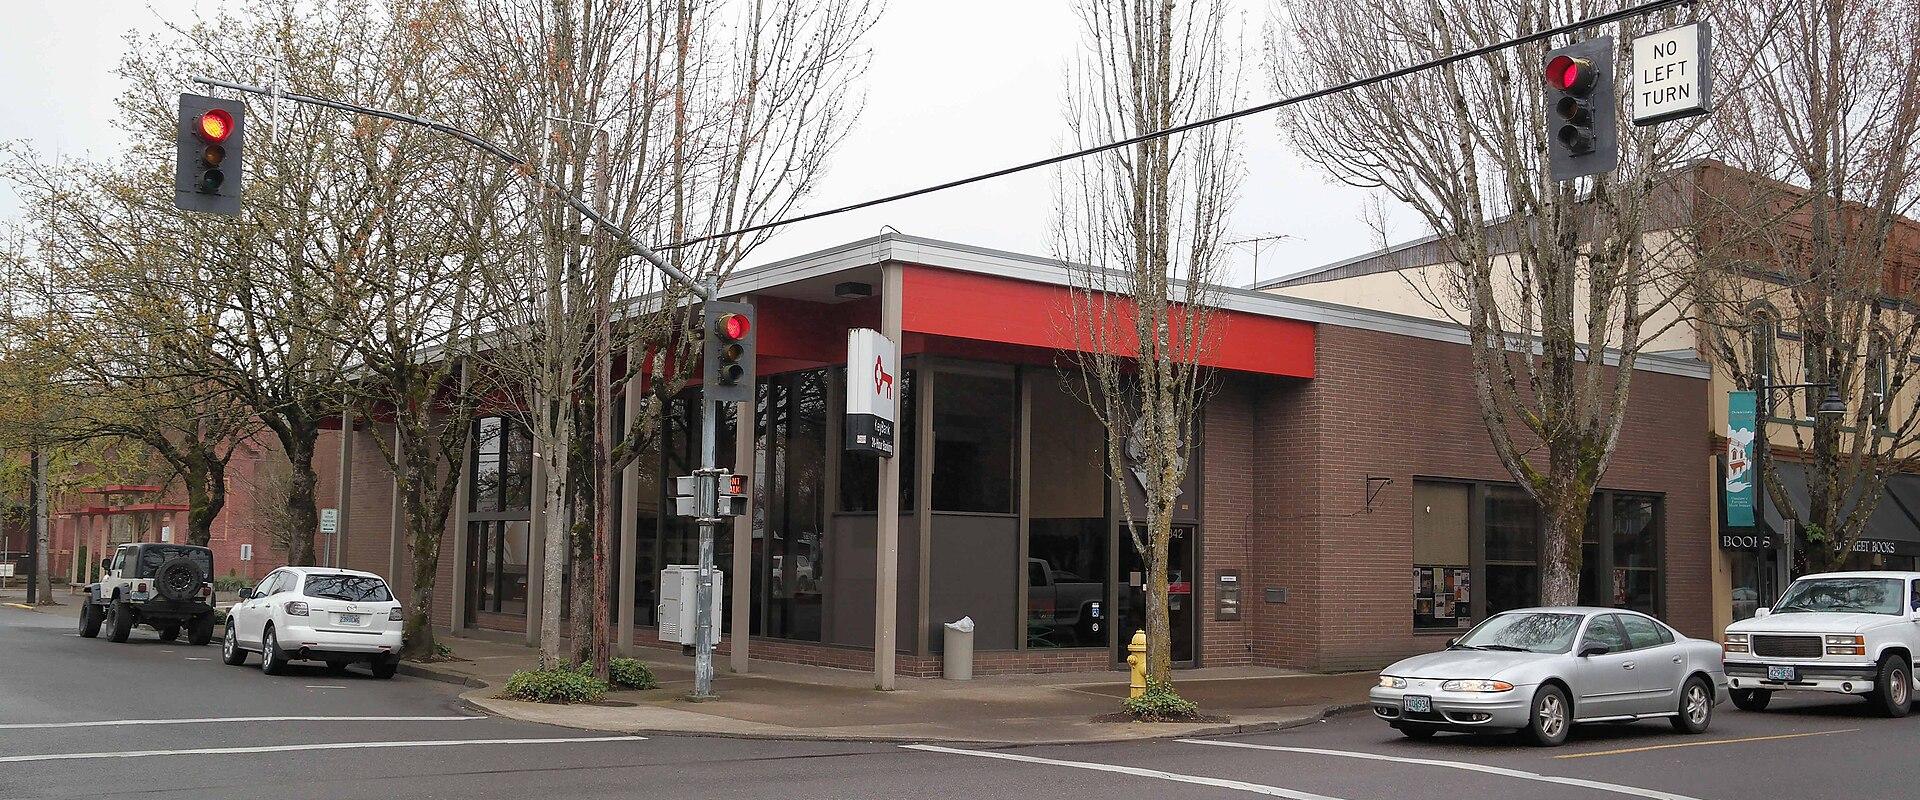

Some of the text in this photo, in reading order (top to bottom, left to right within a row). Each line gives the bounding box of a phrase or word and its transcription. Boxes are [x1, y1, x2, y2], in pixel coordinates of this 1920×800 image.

[1654, 40, 1677, 60] NO
[1644, 60, 1688, 85] LEFT
[1642, 83, 1690, 107] TURN
[1872, 541, 1896, 554] BOOKS
